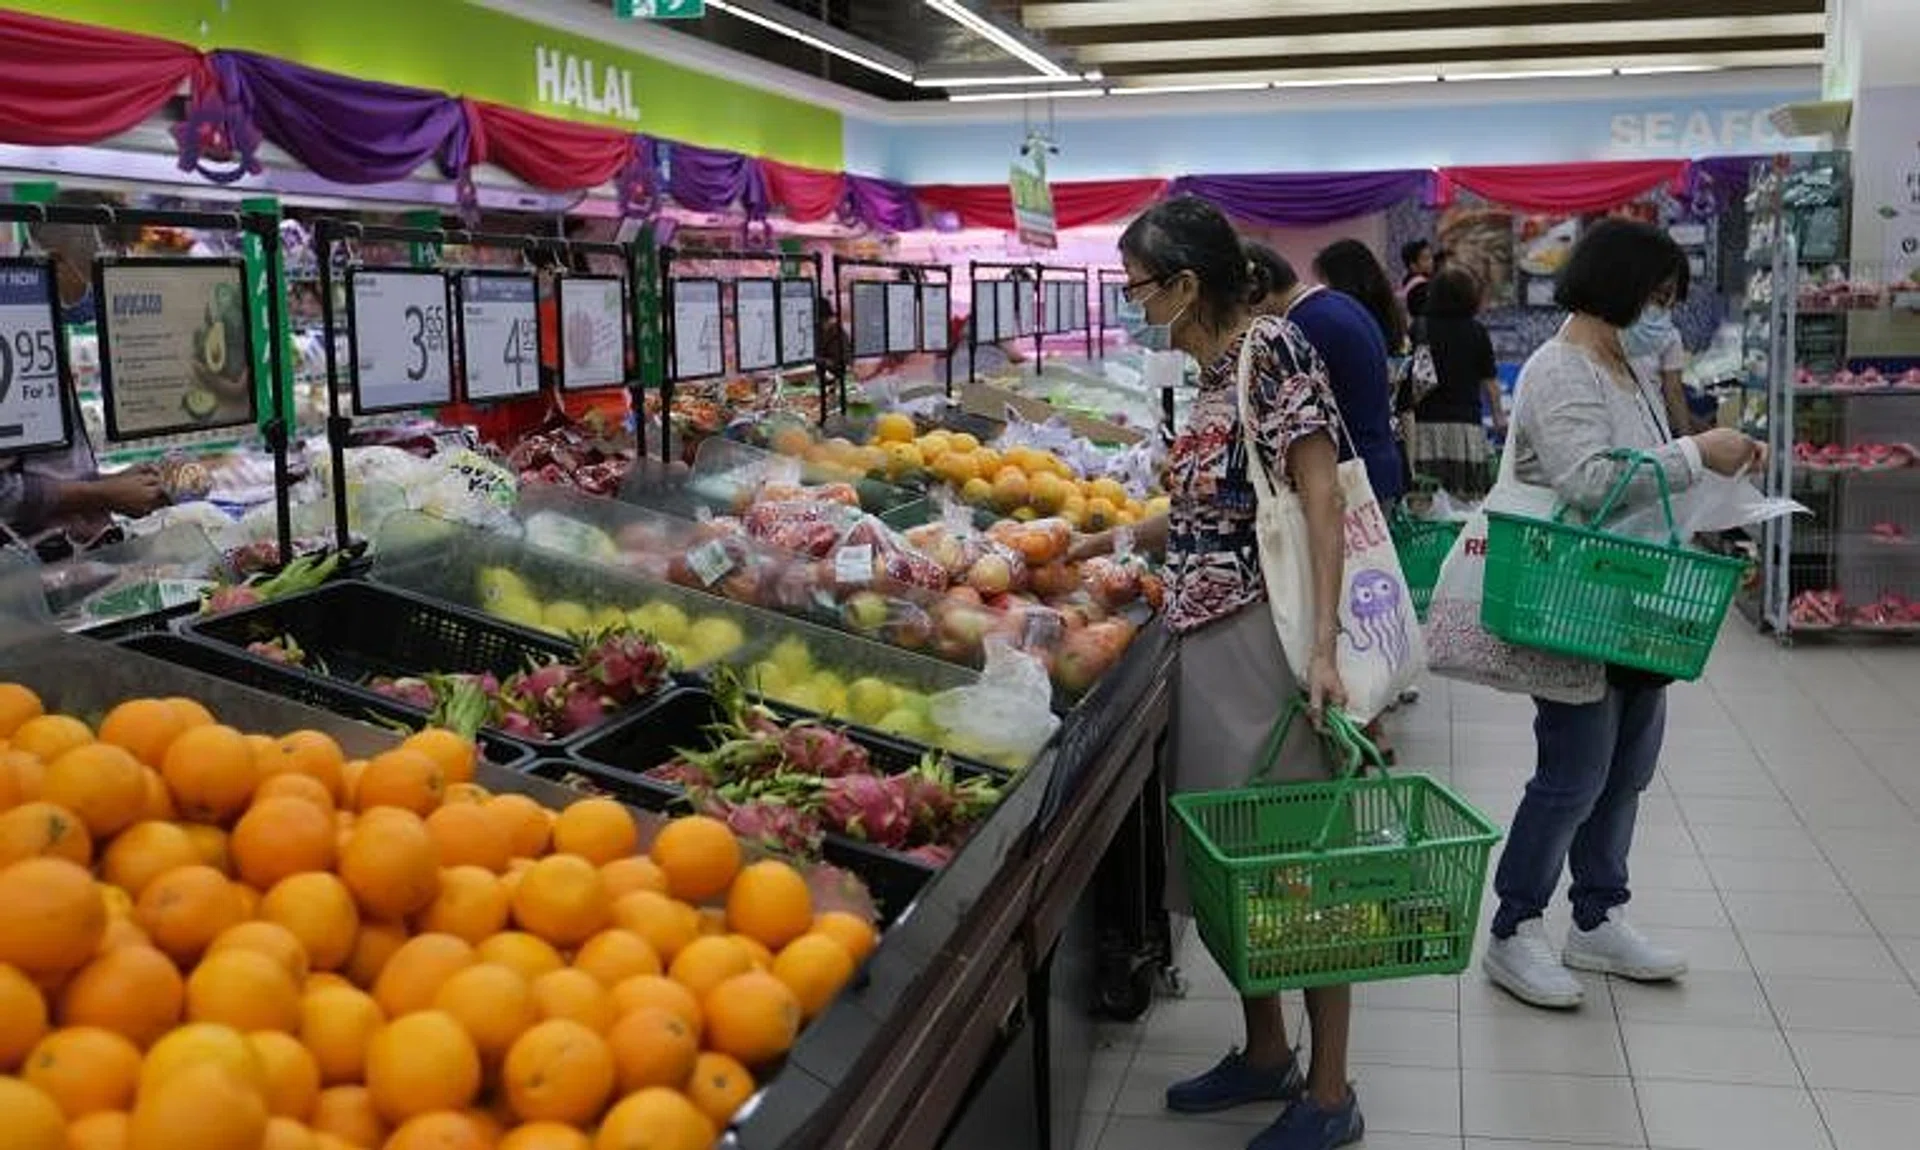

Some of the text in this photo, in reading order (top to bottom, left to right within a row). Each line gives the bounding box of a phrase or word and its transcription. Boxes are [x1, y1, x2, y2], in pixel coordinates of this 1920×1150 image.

[536, 45, 640, 121] HALAL
[15, 330, 55, 374] 95
[405, 304, 428, 381] 3
[503, 317, 524, 387] 4
